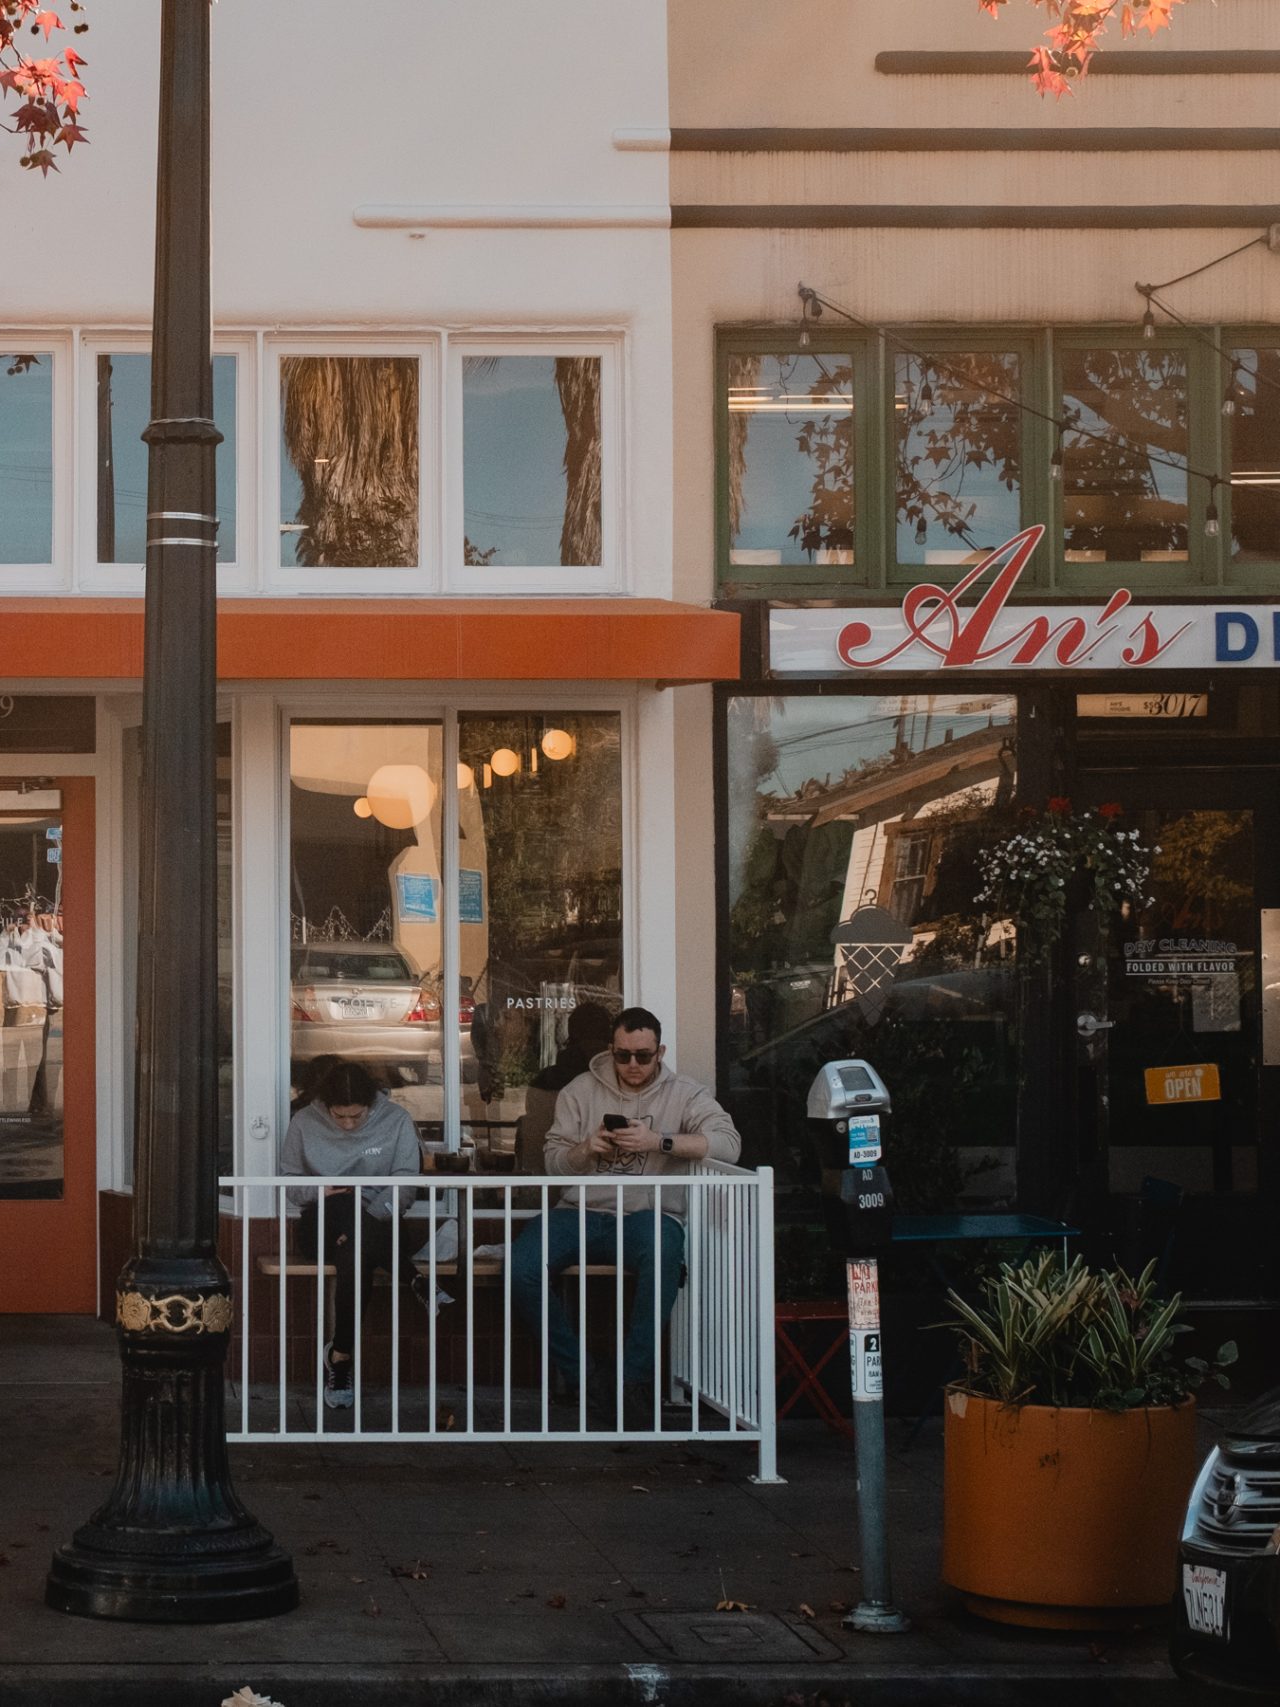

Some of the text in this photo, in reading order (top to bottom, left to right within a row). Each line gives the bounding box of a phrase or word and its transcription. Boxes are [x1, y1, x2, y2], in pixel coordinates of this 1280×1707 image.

[837, 524, 1280, 669] An's D
[1123, 938, 1238, 955] DRY CLEANING
[1126, 961, 1236, 973] FOLDED WITH FLAVOR
[506, 997, 577, 1009] PASTRIES
[1165, 1078, 1202, 1099] OPEN
[853, 1150, 878, 1160] AD-3009
[861, 1168, 874, 1182] AD
[858, 1193, 885, 1209] 3009
[869, 1337, 877, 1351] 2
